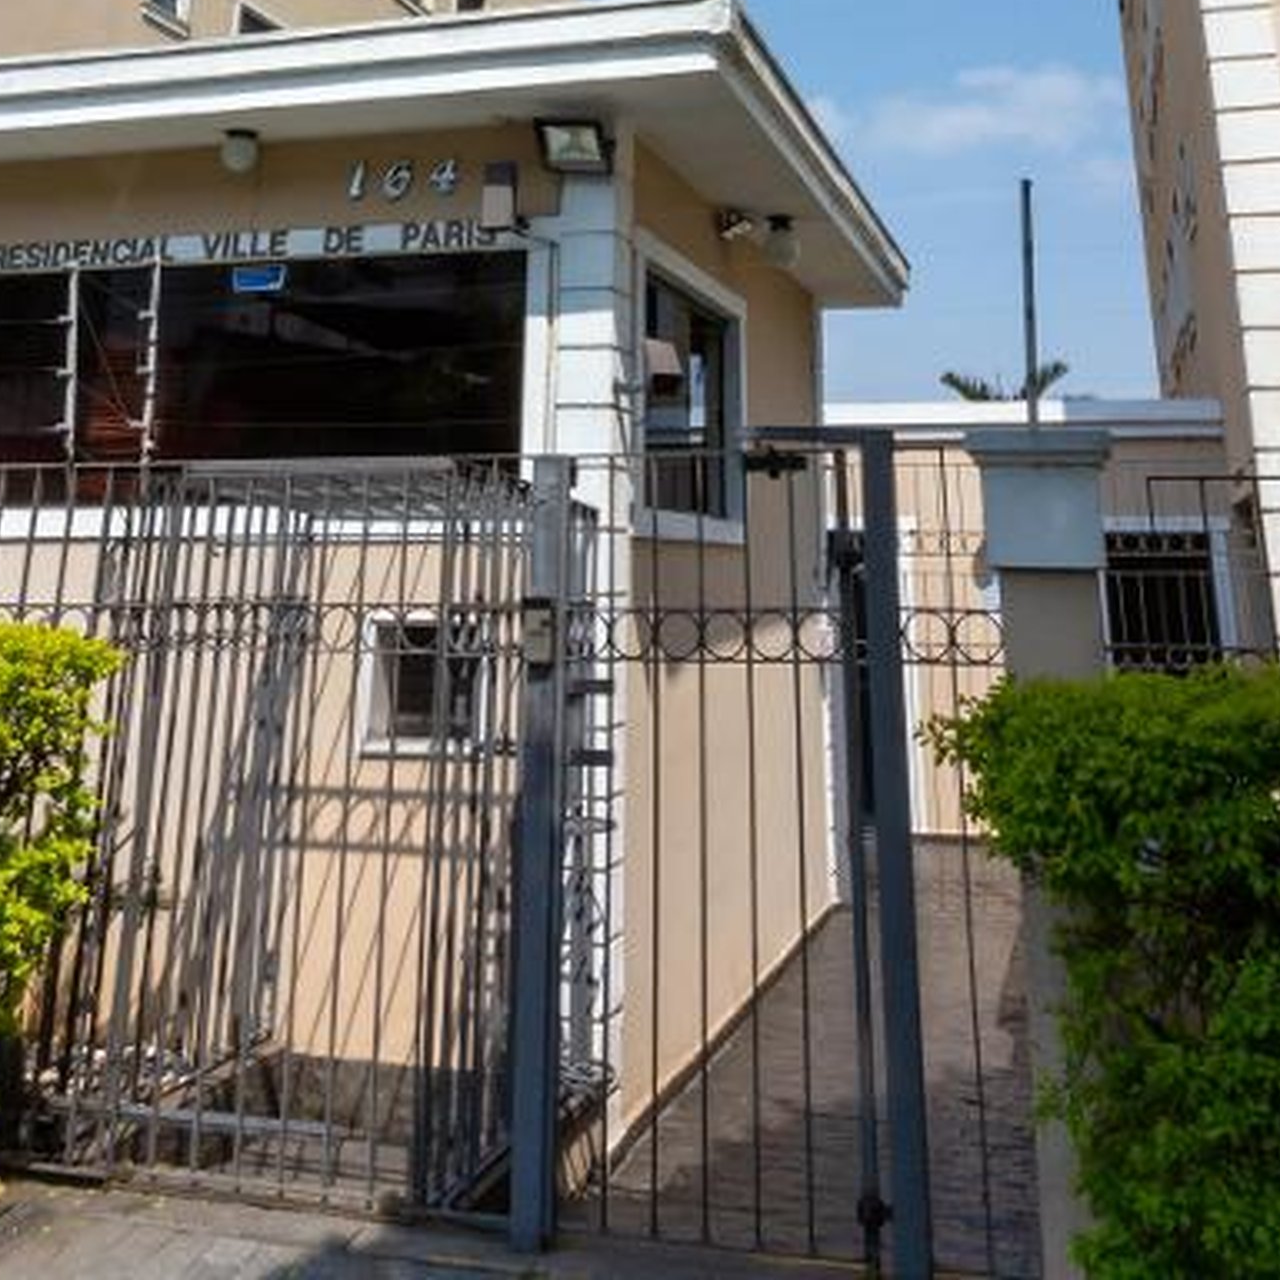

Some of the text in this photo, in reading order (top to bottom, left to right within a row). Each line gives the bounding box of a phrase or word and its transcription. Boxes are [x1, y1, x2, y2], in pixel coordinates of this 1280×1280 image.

[349, 159, 457, 200] 164
[201, 229, 287, 259] VILLE
[324, 226, 363, 253] DE
[400, 220, 496, 249] PARIS
